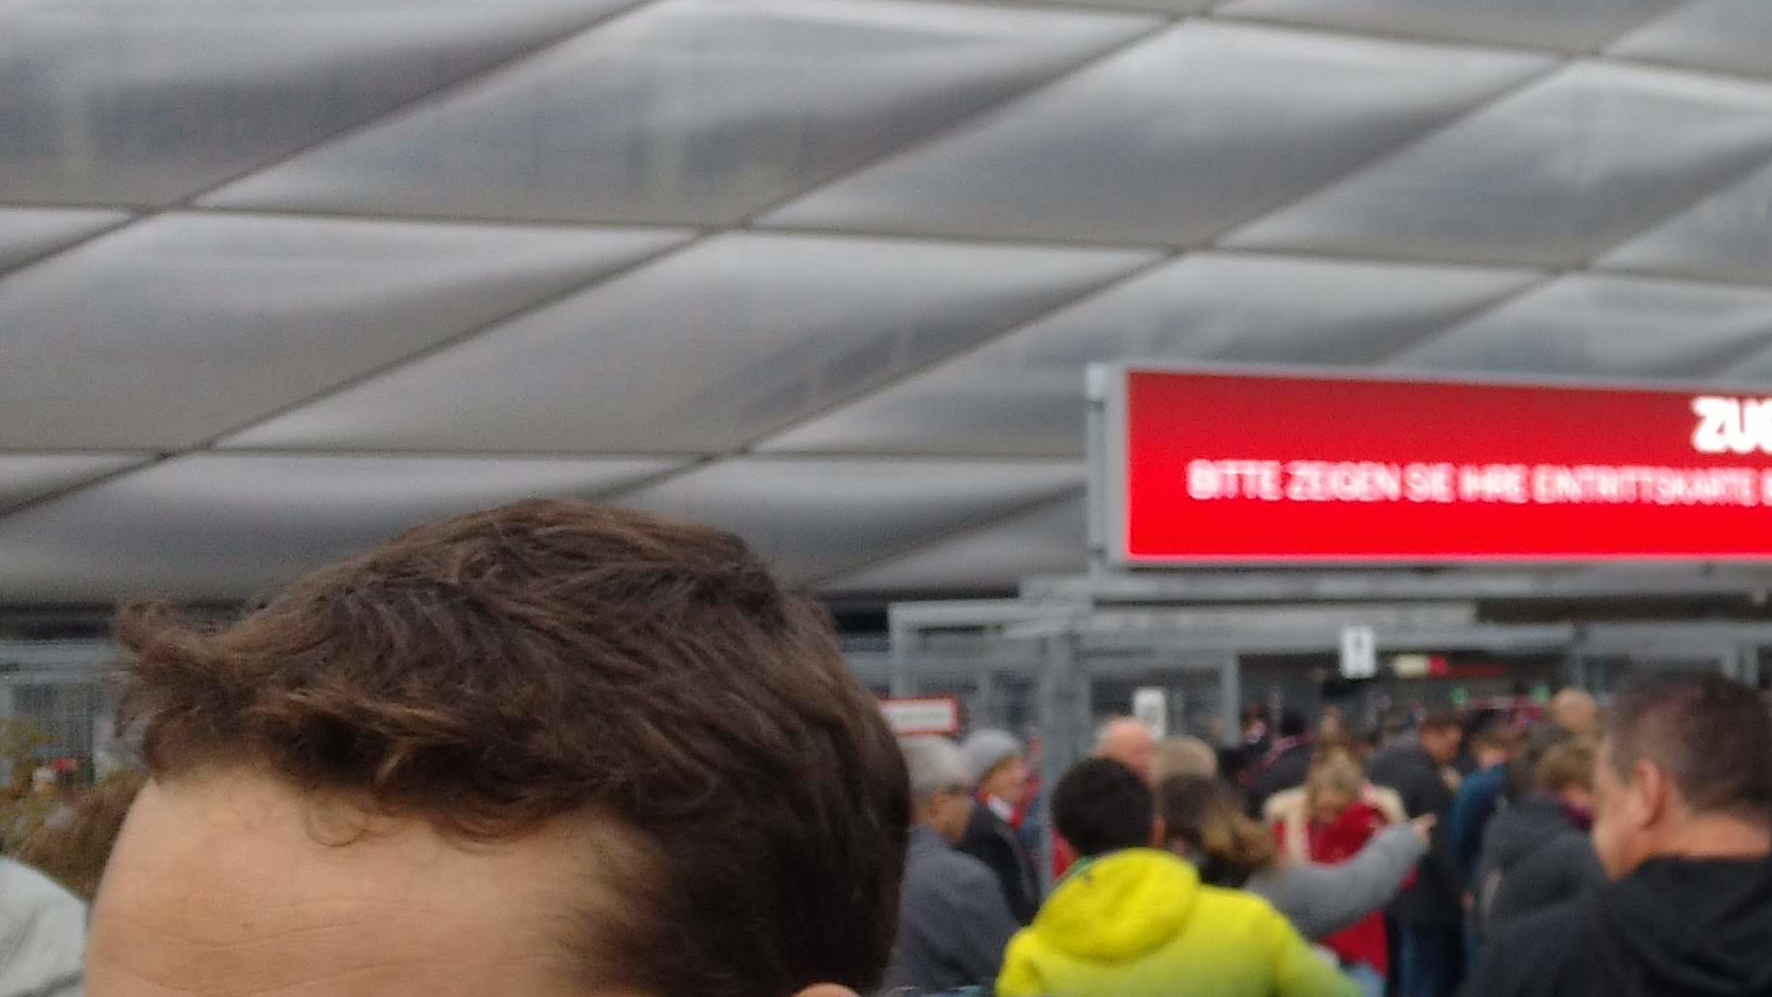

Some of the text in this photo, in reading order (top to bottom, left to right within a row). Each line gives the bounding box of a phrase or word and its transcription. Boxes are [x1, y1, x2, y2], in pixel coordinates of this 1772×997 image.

[1189, 459, 1279, 499] BITTE
[1288, 461, 1401, 501] ZEIGEN
[1405, 463, 1451, 502] SIE
[1460, 464, 1525, 502] IHRE
[1533, 466, 1755, 503] EINTRITTSKARTE
